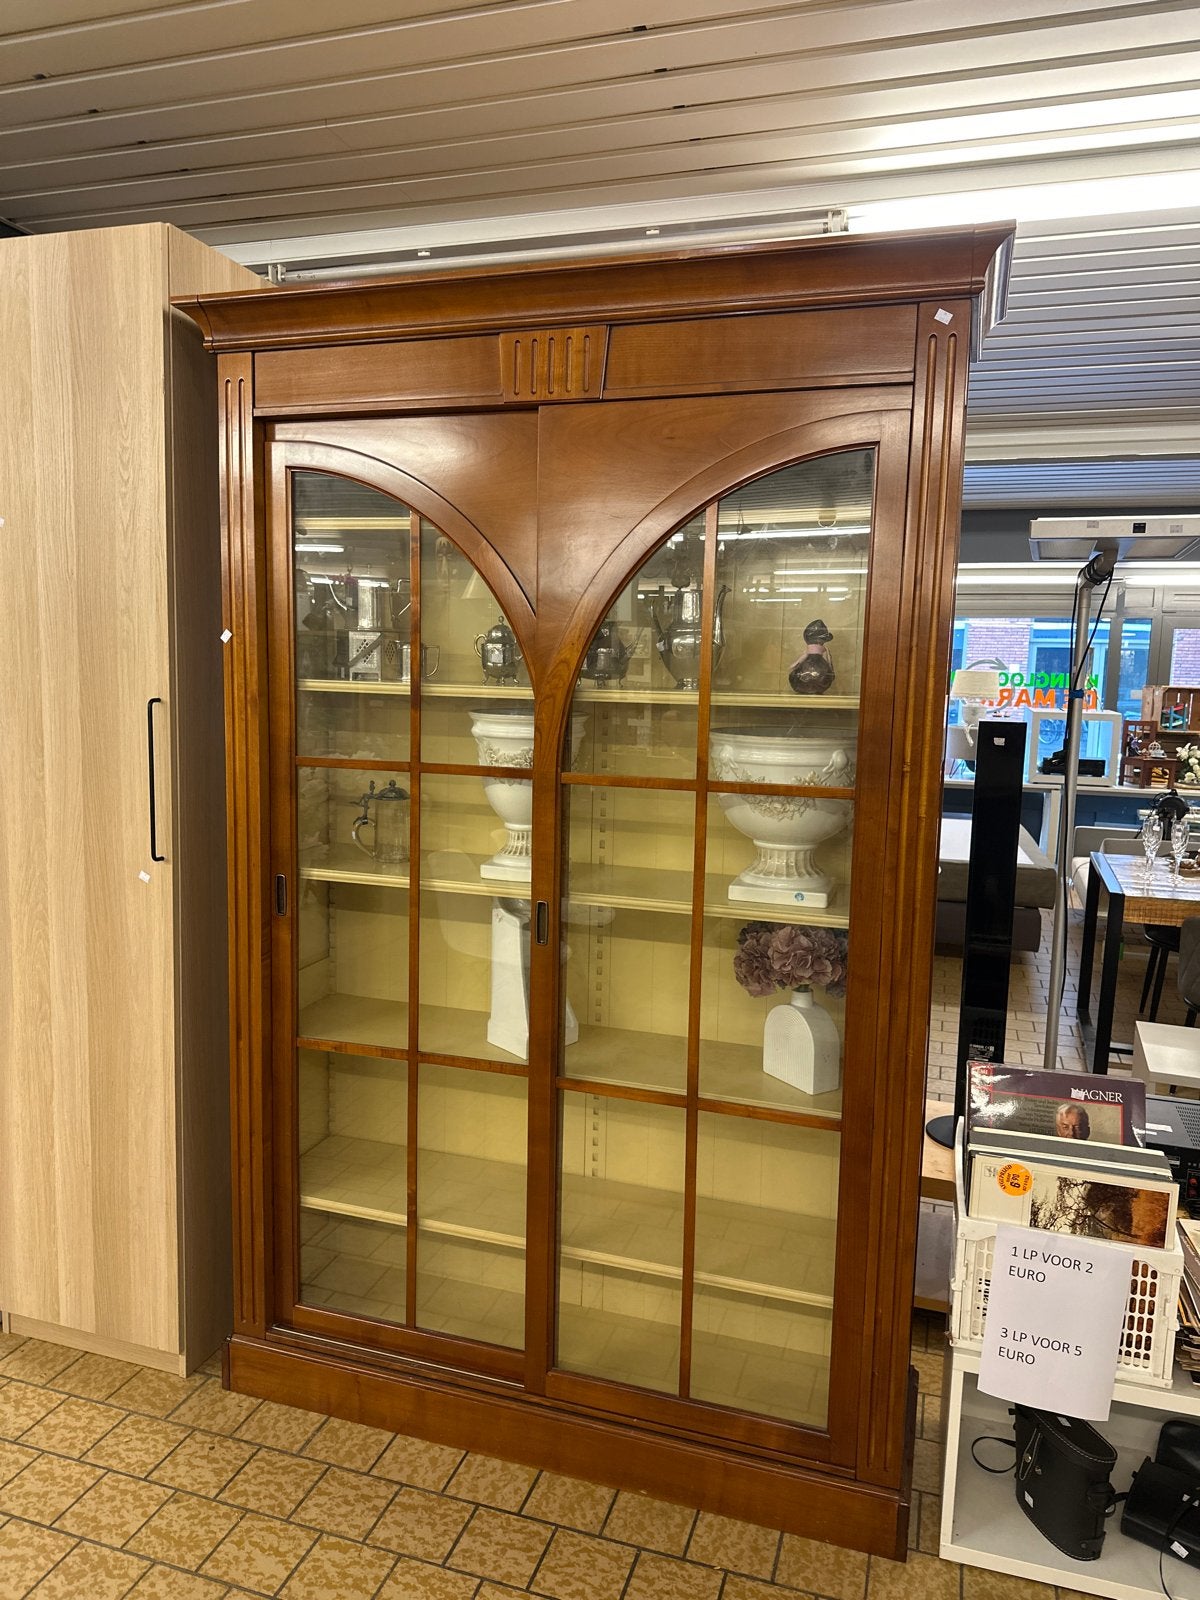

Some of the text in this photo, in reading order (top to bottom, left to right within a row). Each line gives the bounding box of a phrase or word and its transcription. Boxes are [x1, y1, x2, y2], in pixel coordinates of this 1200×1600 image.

[1011, 1246, 1094, 1274] 1 LP VOOR 2
[1008, 1265, 1046, 1283] EURO
[1000, 1327, 1082, 1356] 3 LP VOOR 5
[998, 1346, 1036, 1365] EURO
